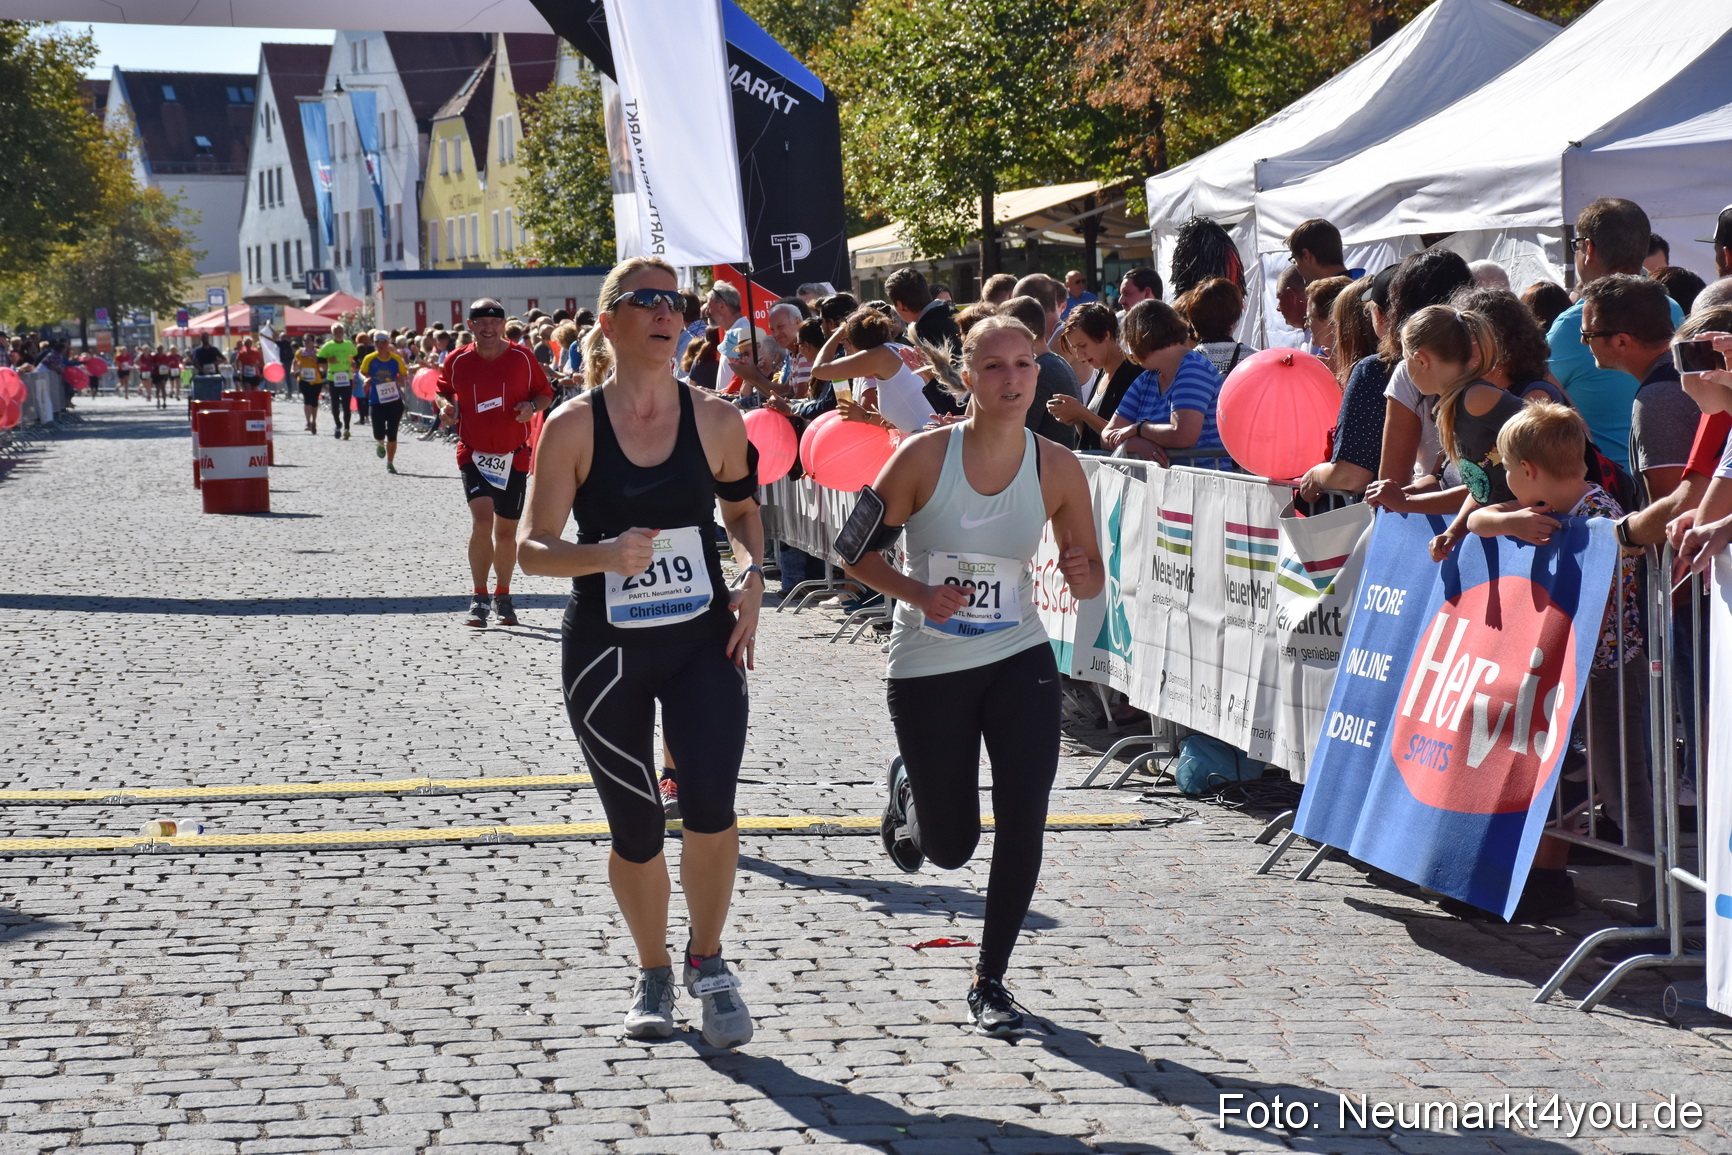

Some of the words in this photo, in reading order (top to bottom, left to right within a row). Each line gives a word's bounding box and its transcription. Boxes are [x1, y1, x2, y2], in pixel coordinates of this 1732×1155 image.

[477, 455, 507, 472] 2434
[958, 561, 996, 573] BOCK
[628, 592, 651, 600] PARTL
[651, 588, 683, 598] Neumarkt
[1363, 584, 1408, 616] STORE
[629, 602, 693, 618] Christiane
[966, 612, 993, 620] Neumarkt
[957, 623, 986, 636] Nina
[1300, 645, 1341, 661] genießen
[1089, 655, 1106, 673] Jura
[1345, 647, 1393, 682] ONLINE
[1404, 733, 1454, 773] SPORTS
